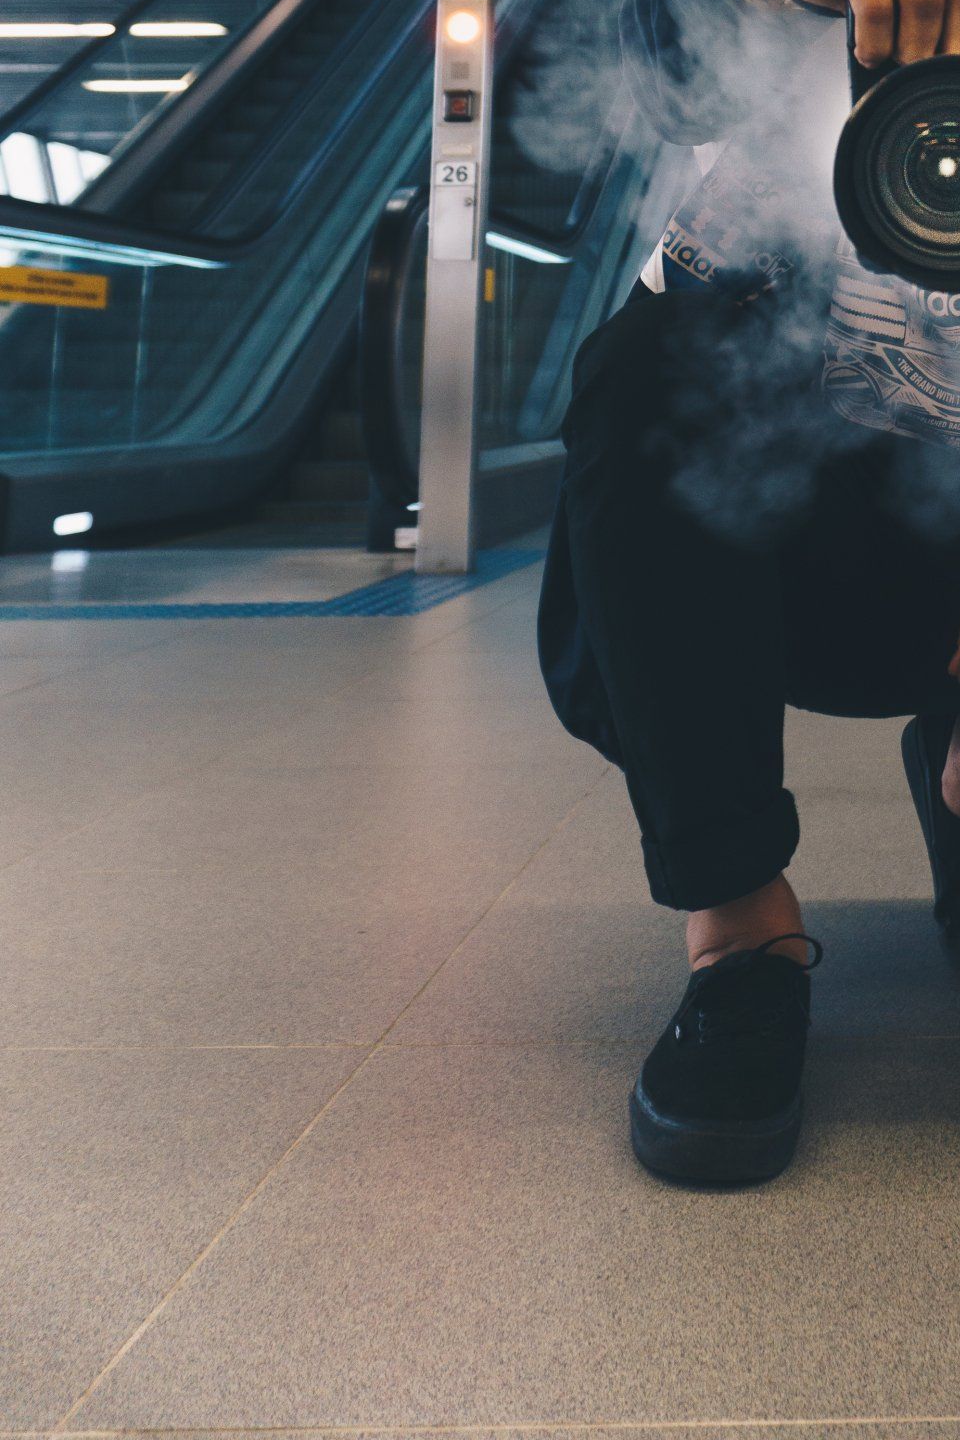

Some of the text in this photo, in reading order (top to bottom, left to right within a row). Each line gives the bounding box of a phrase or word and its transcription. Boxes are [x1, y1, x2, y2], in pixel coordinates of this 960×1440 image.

[442, 165, 468, 182] 26
[898, 359, 914, 375] THE
[910, 372, 937, 395] BRAND
[936, 388, 955, 404] WITH
